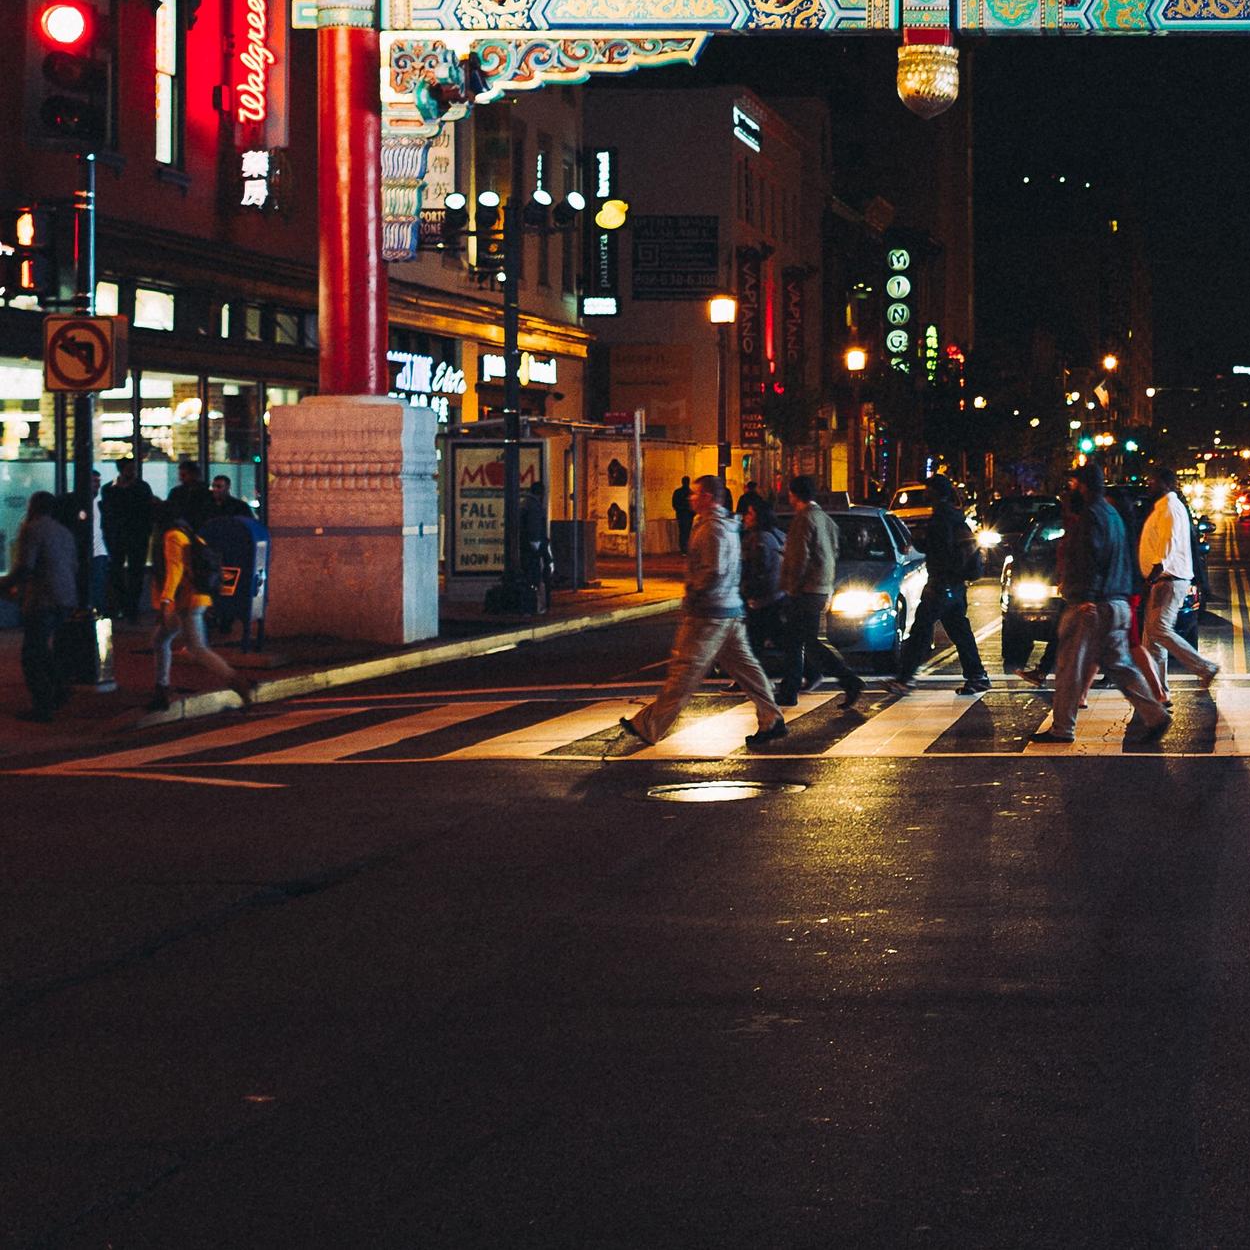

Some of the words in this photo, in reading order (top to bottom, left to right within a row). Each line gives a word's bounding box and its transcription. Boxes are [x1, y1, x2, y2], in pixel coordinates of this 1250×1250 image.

[598, 233, 611, 289] panera
[460, 502, 496, 518] FALL
[460, 552, 489, 566] NOW
